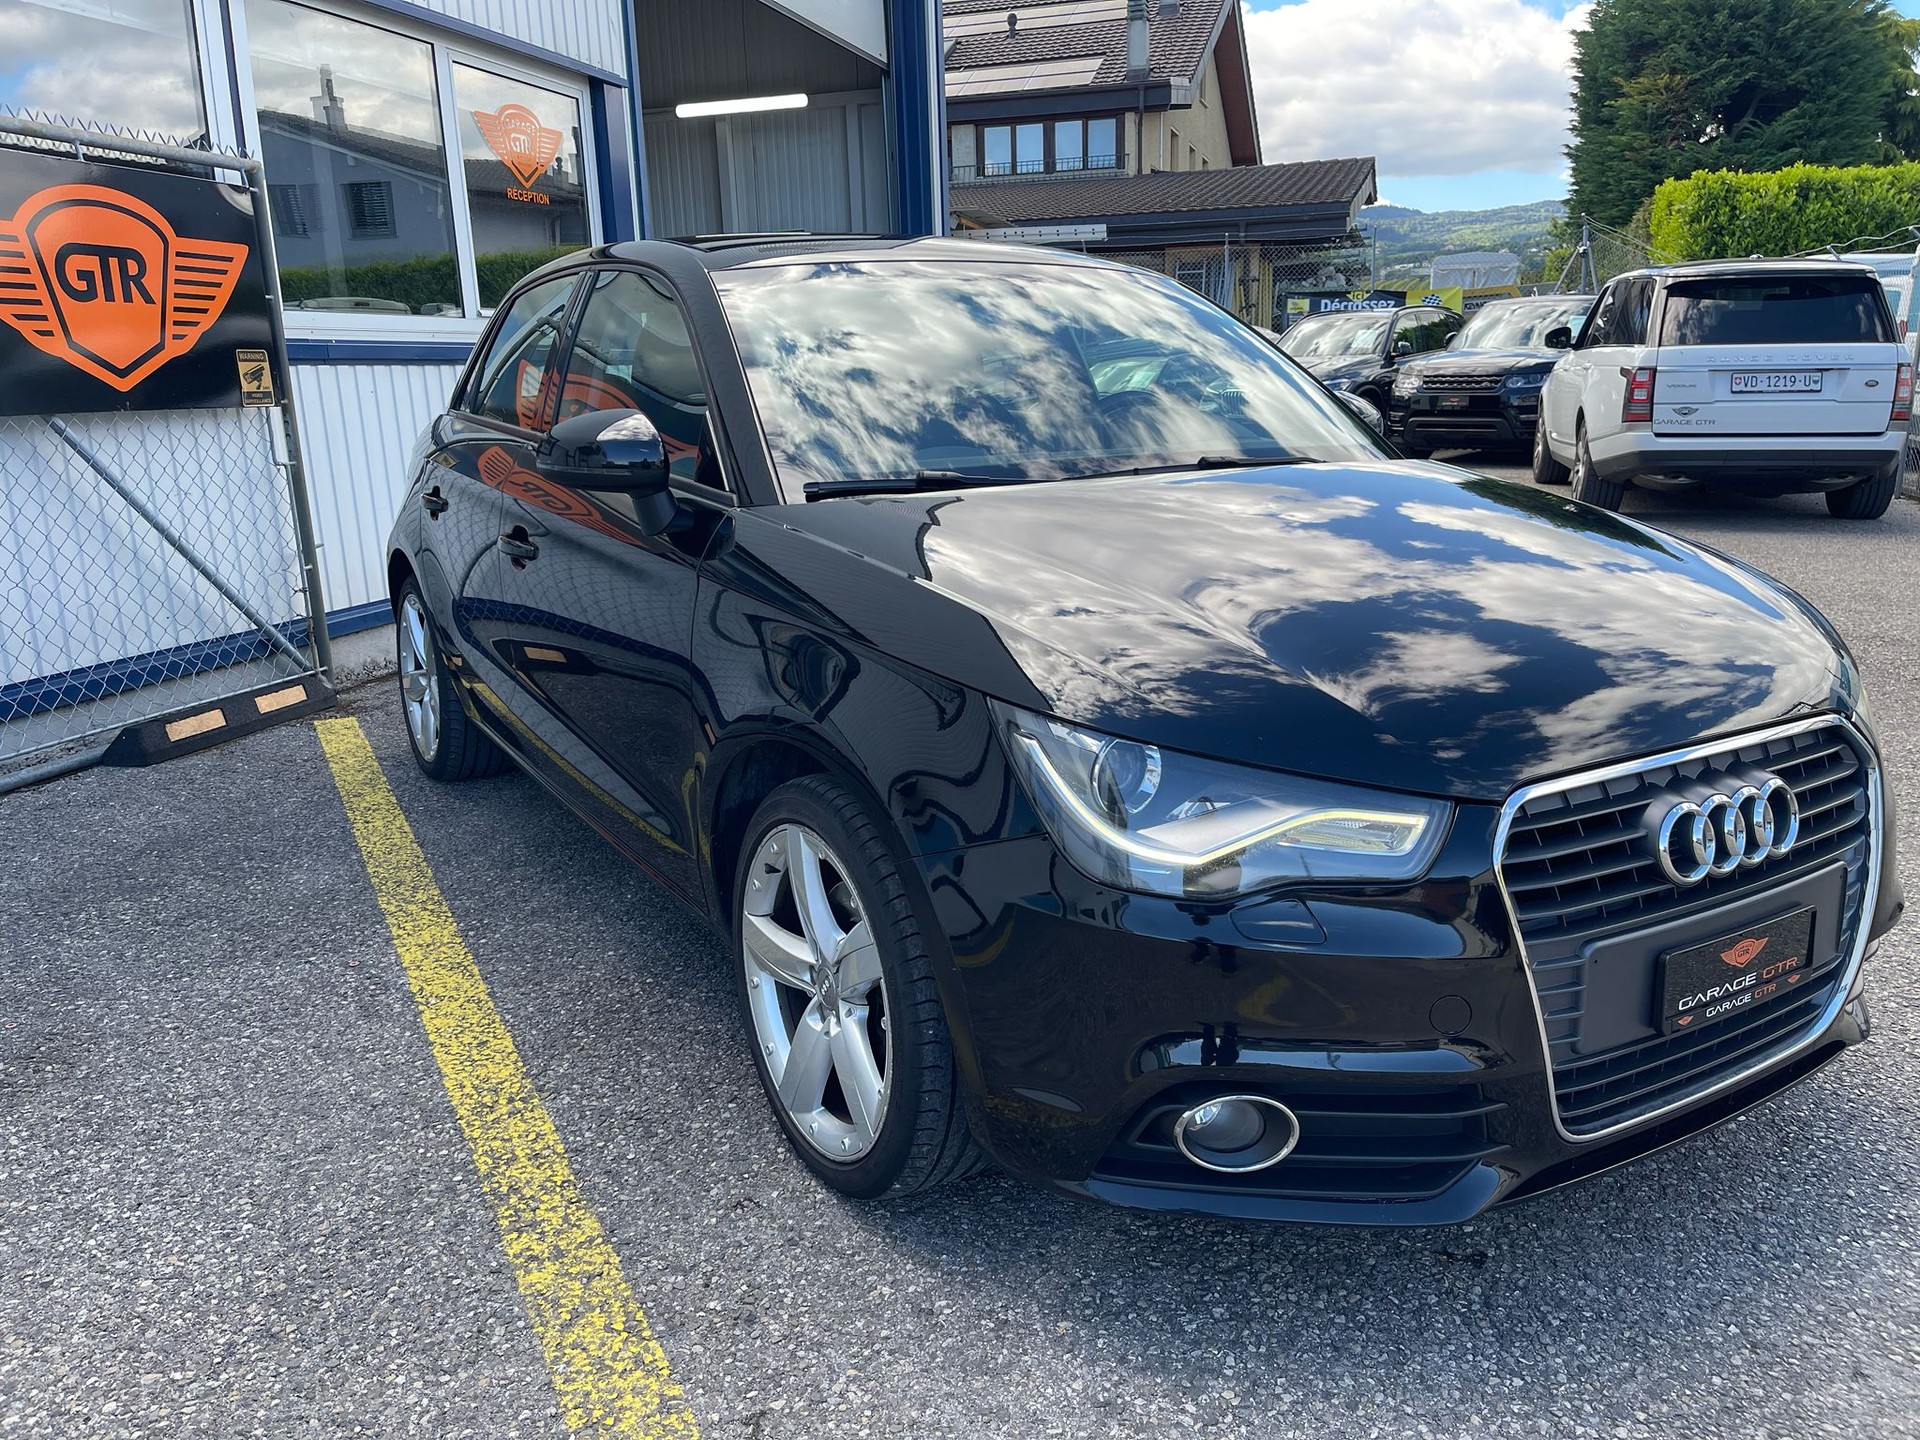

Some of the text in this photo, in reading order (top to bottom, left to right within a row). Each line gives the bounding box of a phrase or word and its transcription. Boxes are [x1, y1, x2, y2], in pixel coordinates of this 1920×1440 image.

[510, 132, 535, 156] GTR
[506, 186, 550, 205] RÉCEPTION
[54, 242, 157, 305] GTR
[1320, 298, 1395, 312] Décrassez
[1738, 948, 1750, 958] GTR
[1678, 956, 1799, 1011] GARAGE GTR
[1706, 983, 1777, 1017] GARAGE GTR
